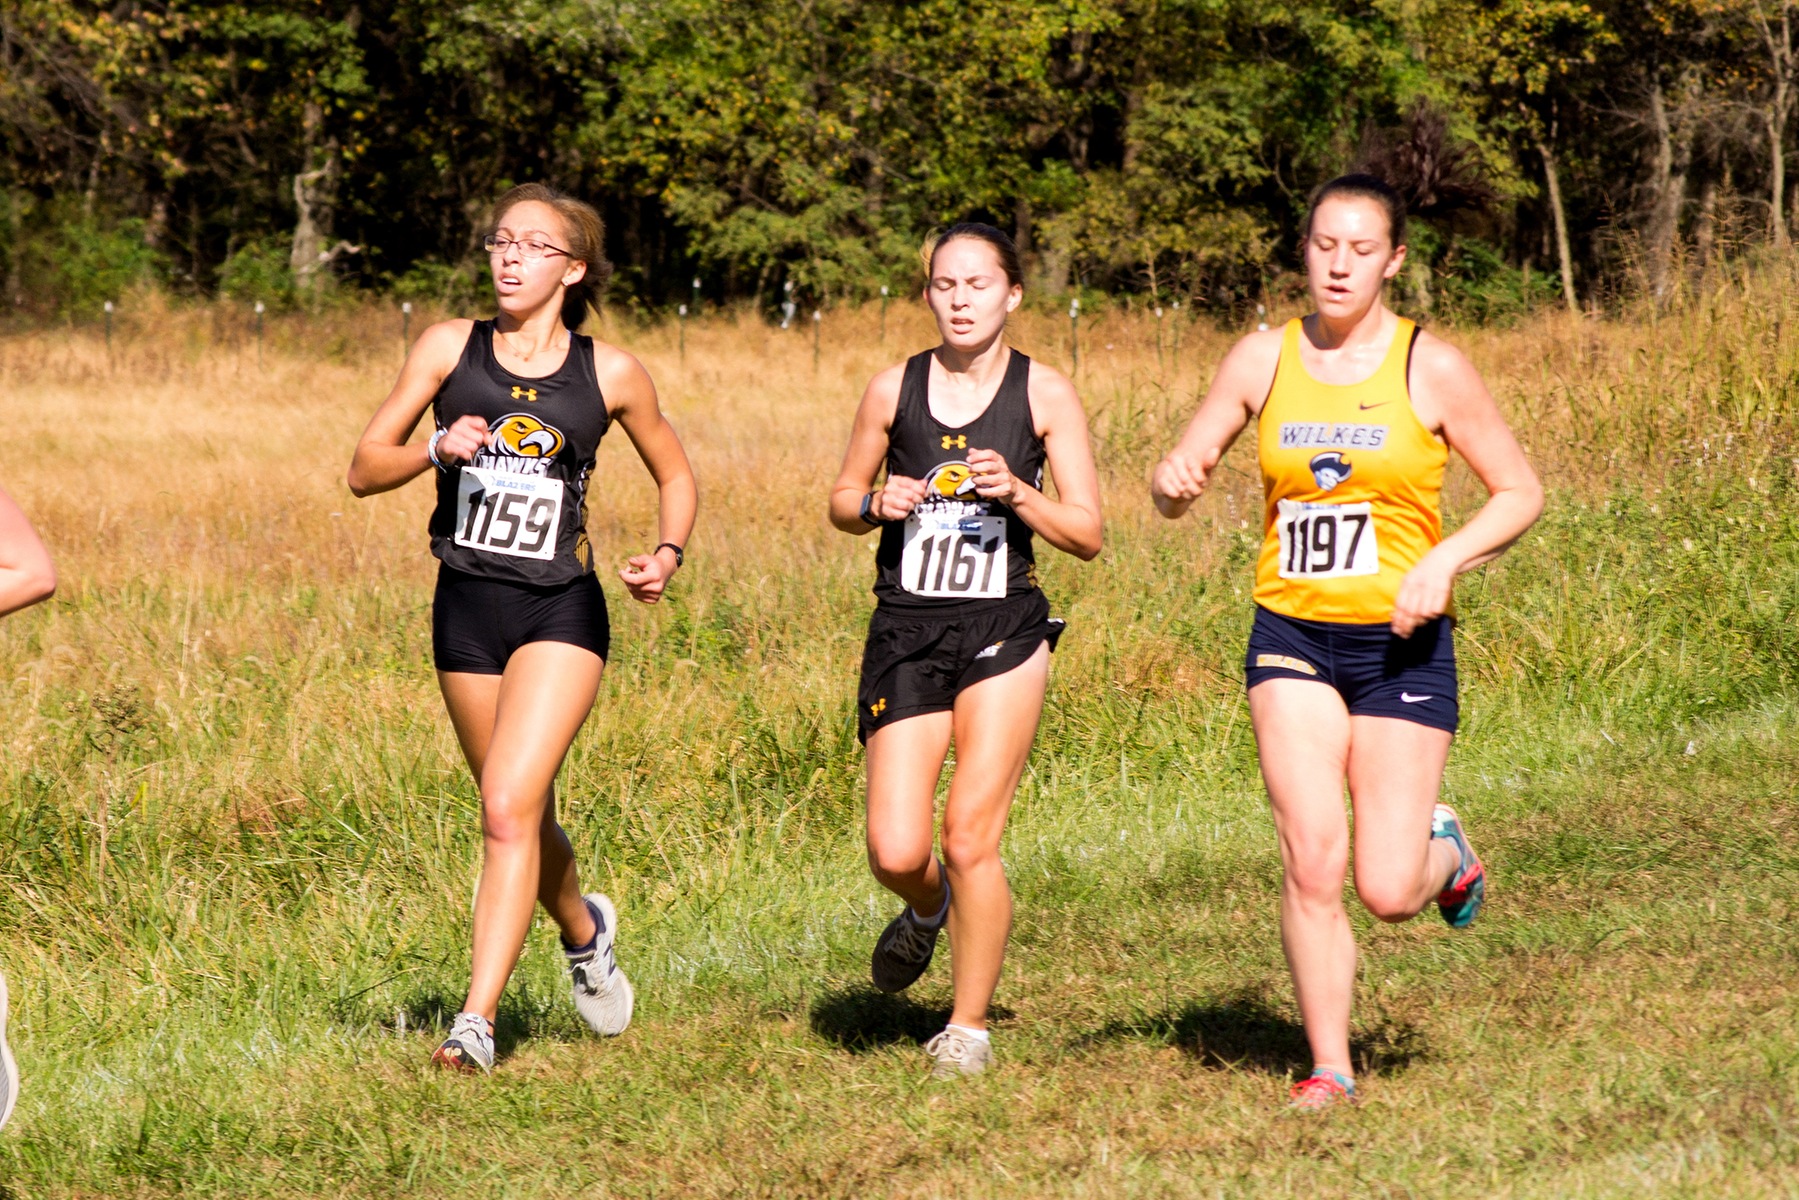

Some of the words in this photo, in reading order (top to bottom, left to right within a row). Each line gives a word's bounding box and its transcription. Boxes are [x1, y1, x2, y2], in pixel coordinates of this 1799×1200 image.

[480, 455, 552, 477] HAWKS
[1280, 424, 1388, 449] WILKES
[461, 488, 556, 552] 1159
[1286, 514, 1368, 573] 1197
[917, 534, 1000, 593] 1161
